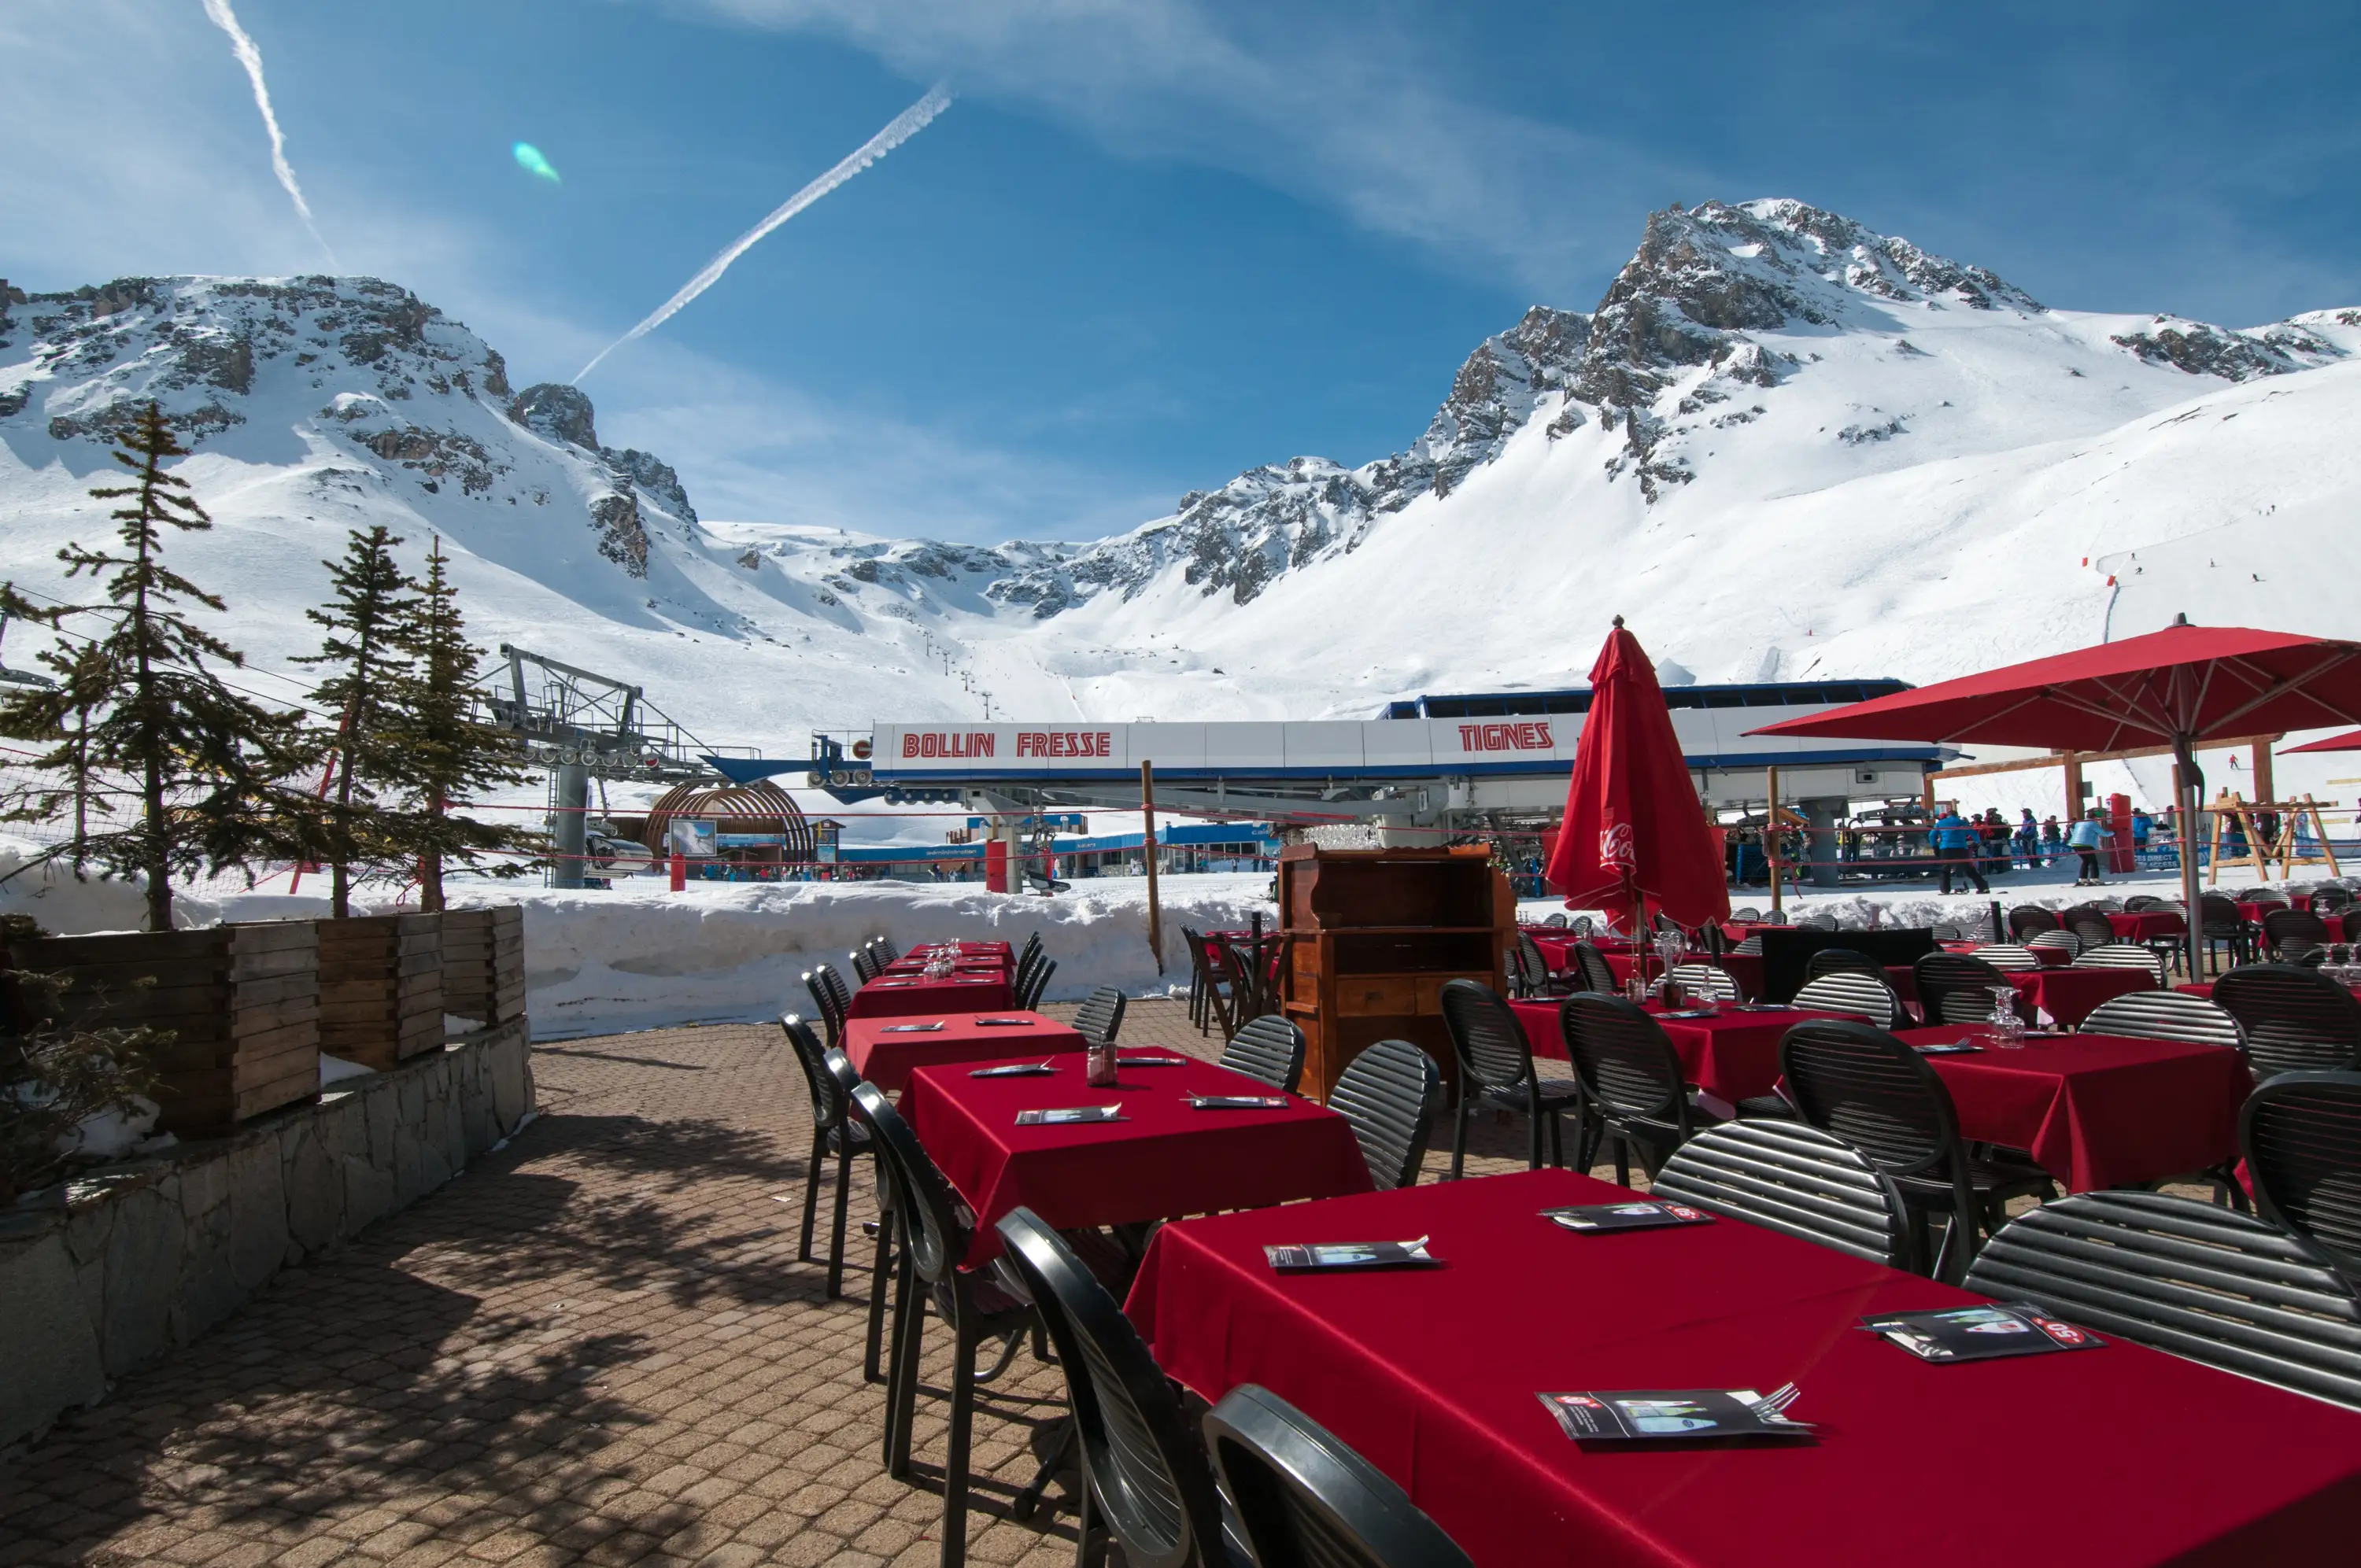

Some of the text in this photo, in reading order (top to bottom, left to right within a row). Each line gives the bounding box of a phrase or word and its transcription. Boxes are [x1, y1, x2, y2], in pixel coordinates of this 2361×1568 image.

[903, 732, 1110, 758] BOLLIN FRESSE
[1458, 722, 1554, 751] TIGNES
